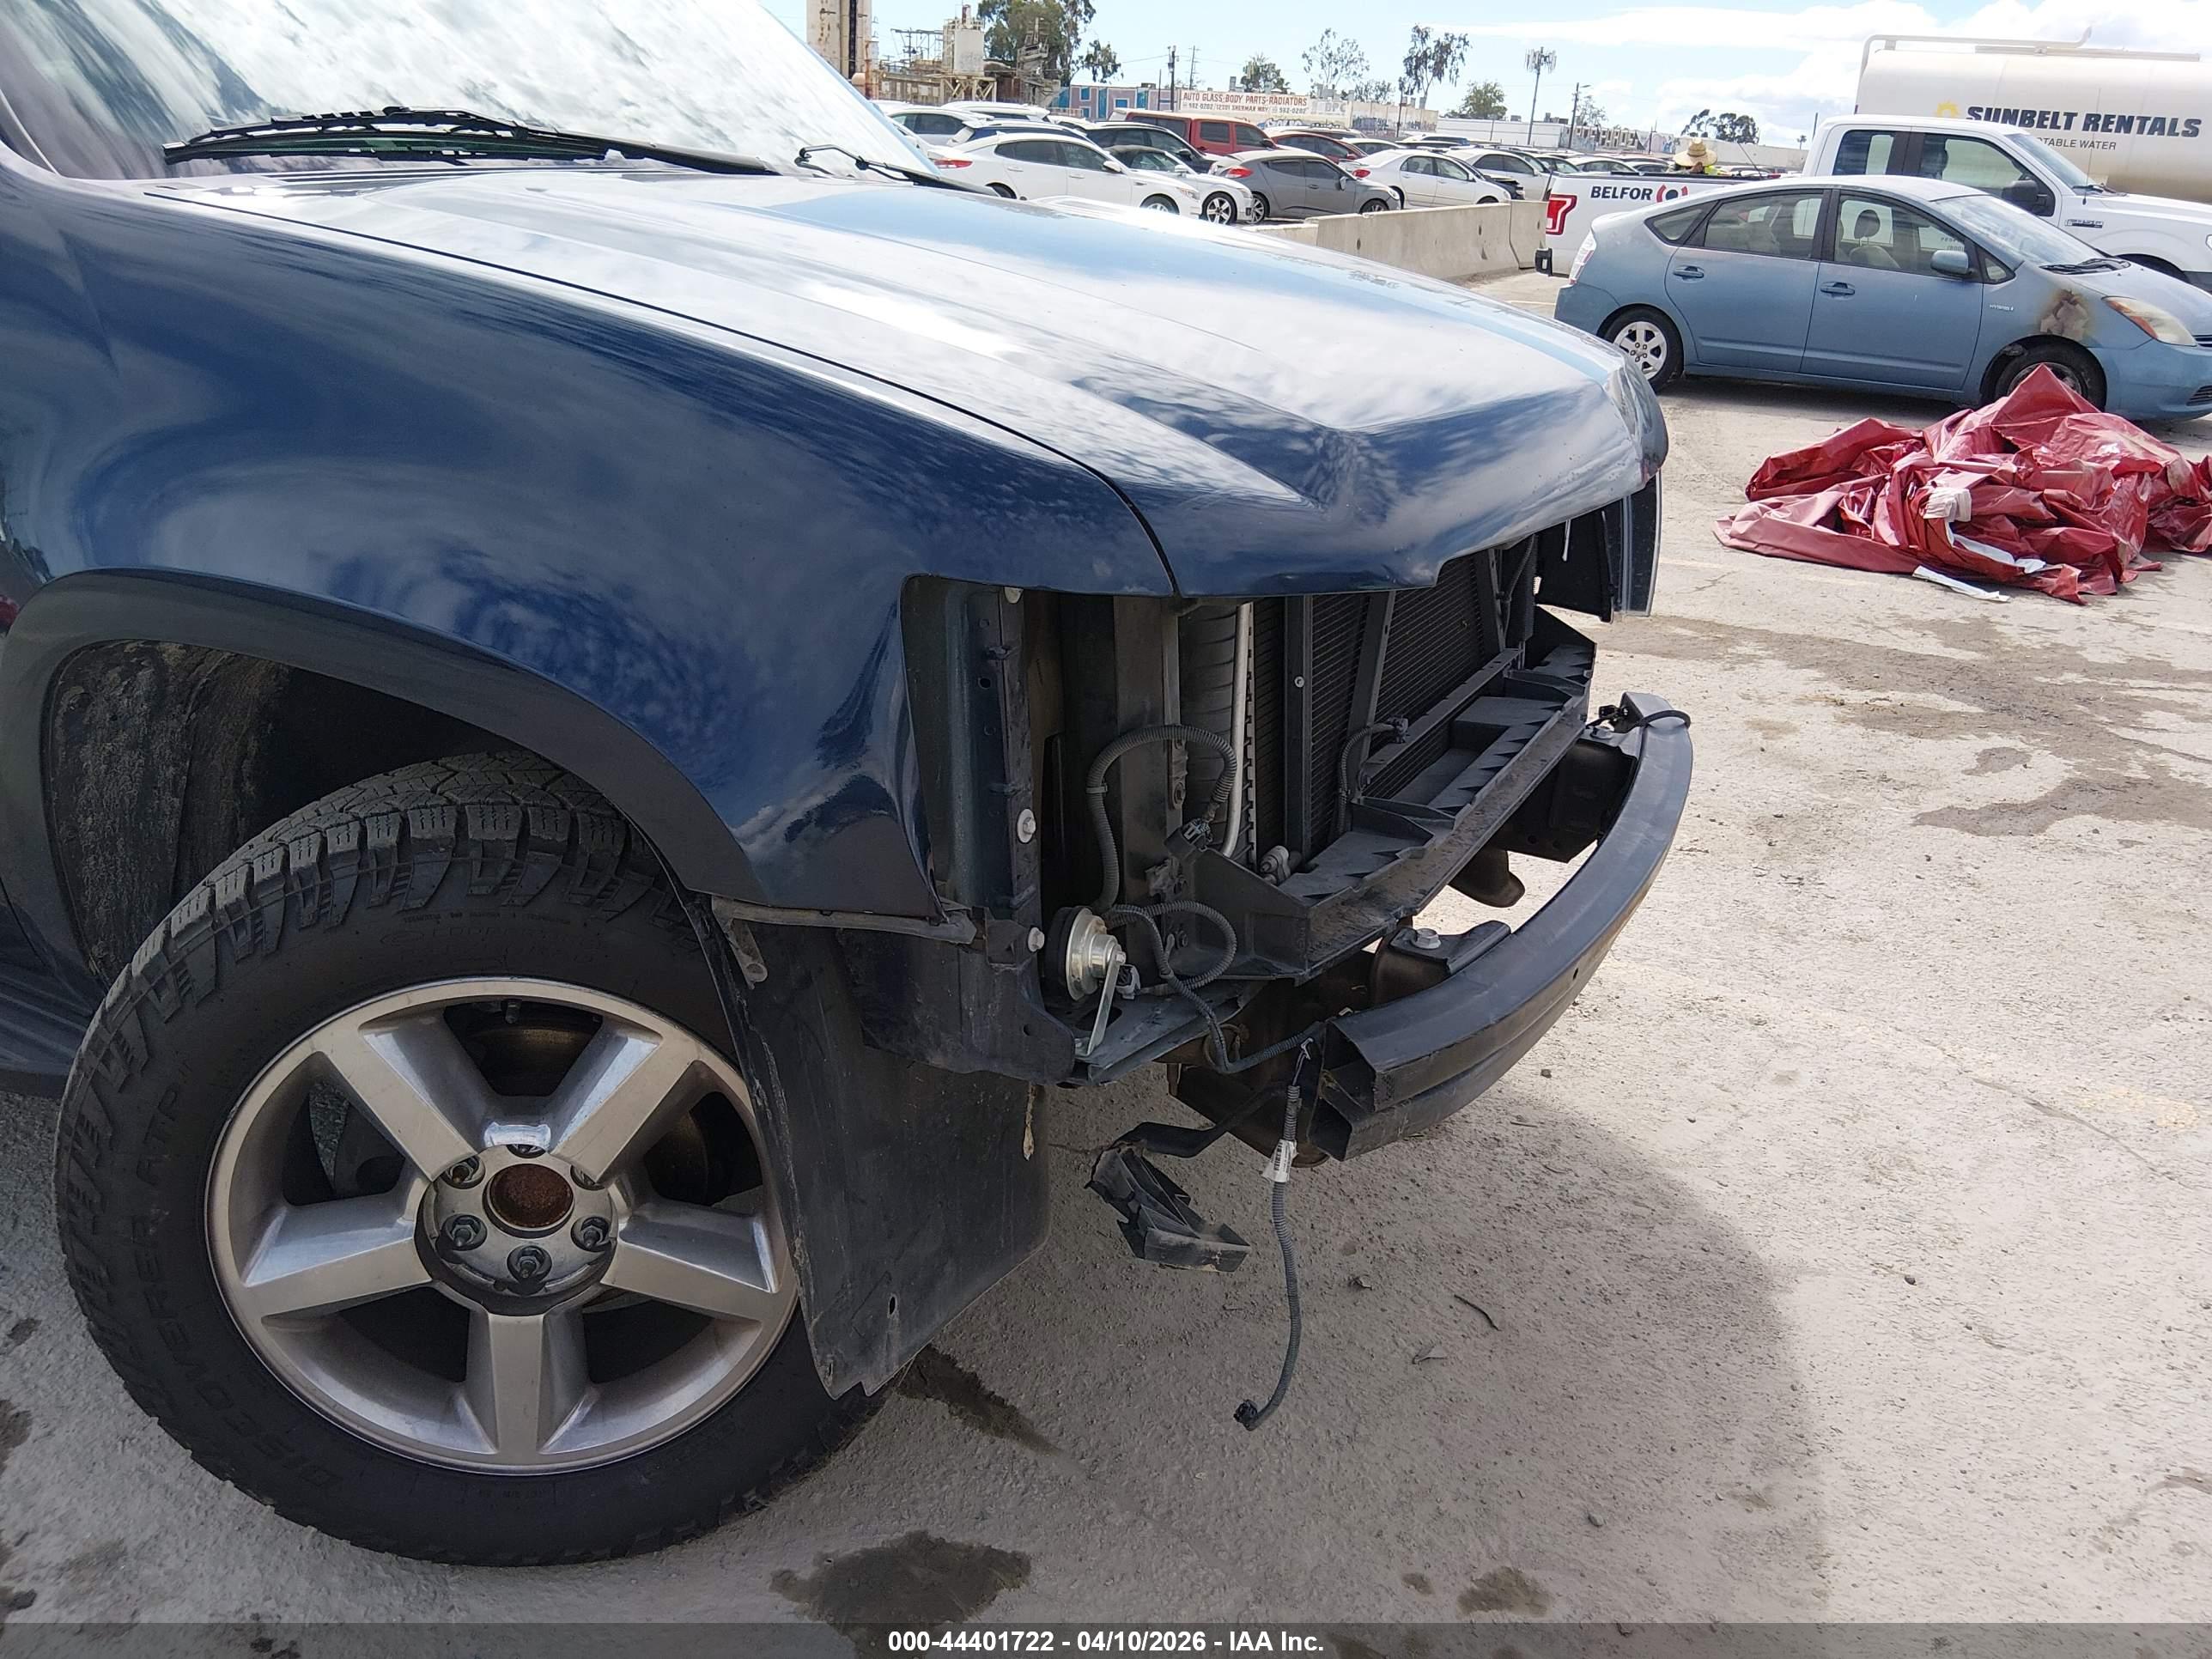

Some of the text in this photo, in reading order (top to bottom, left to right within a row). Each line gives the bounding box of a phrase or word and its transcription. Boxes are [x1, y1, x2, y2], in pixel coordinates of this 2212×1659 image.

[1182, 92, 1200, 101] AUTO
[1966, 106, 2202, 138] SUNBELT RENTALS
[2080, 139, 2117, 150] WATER
[1590, 185, 1653, 201] BELFOR
